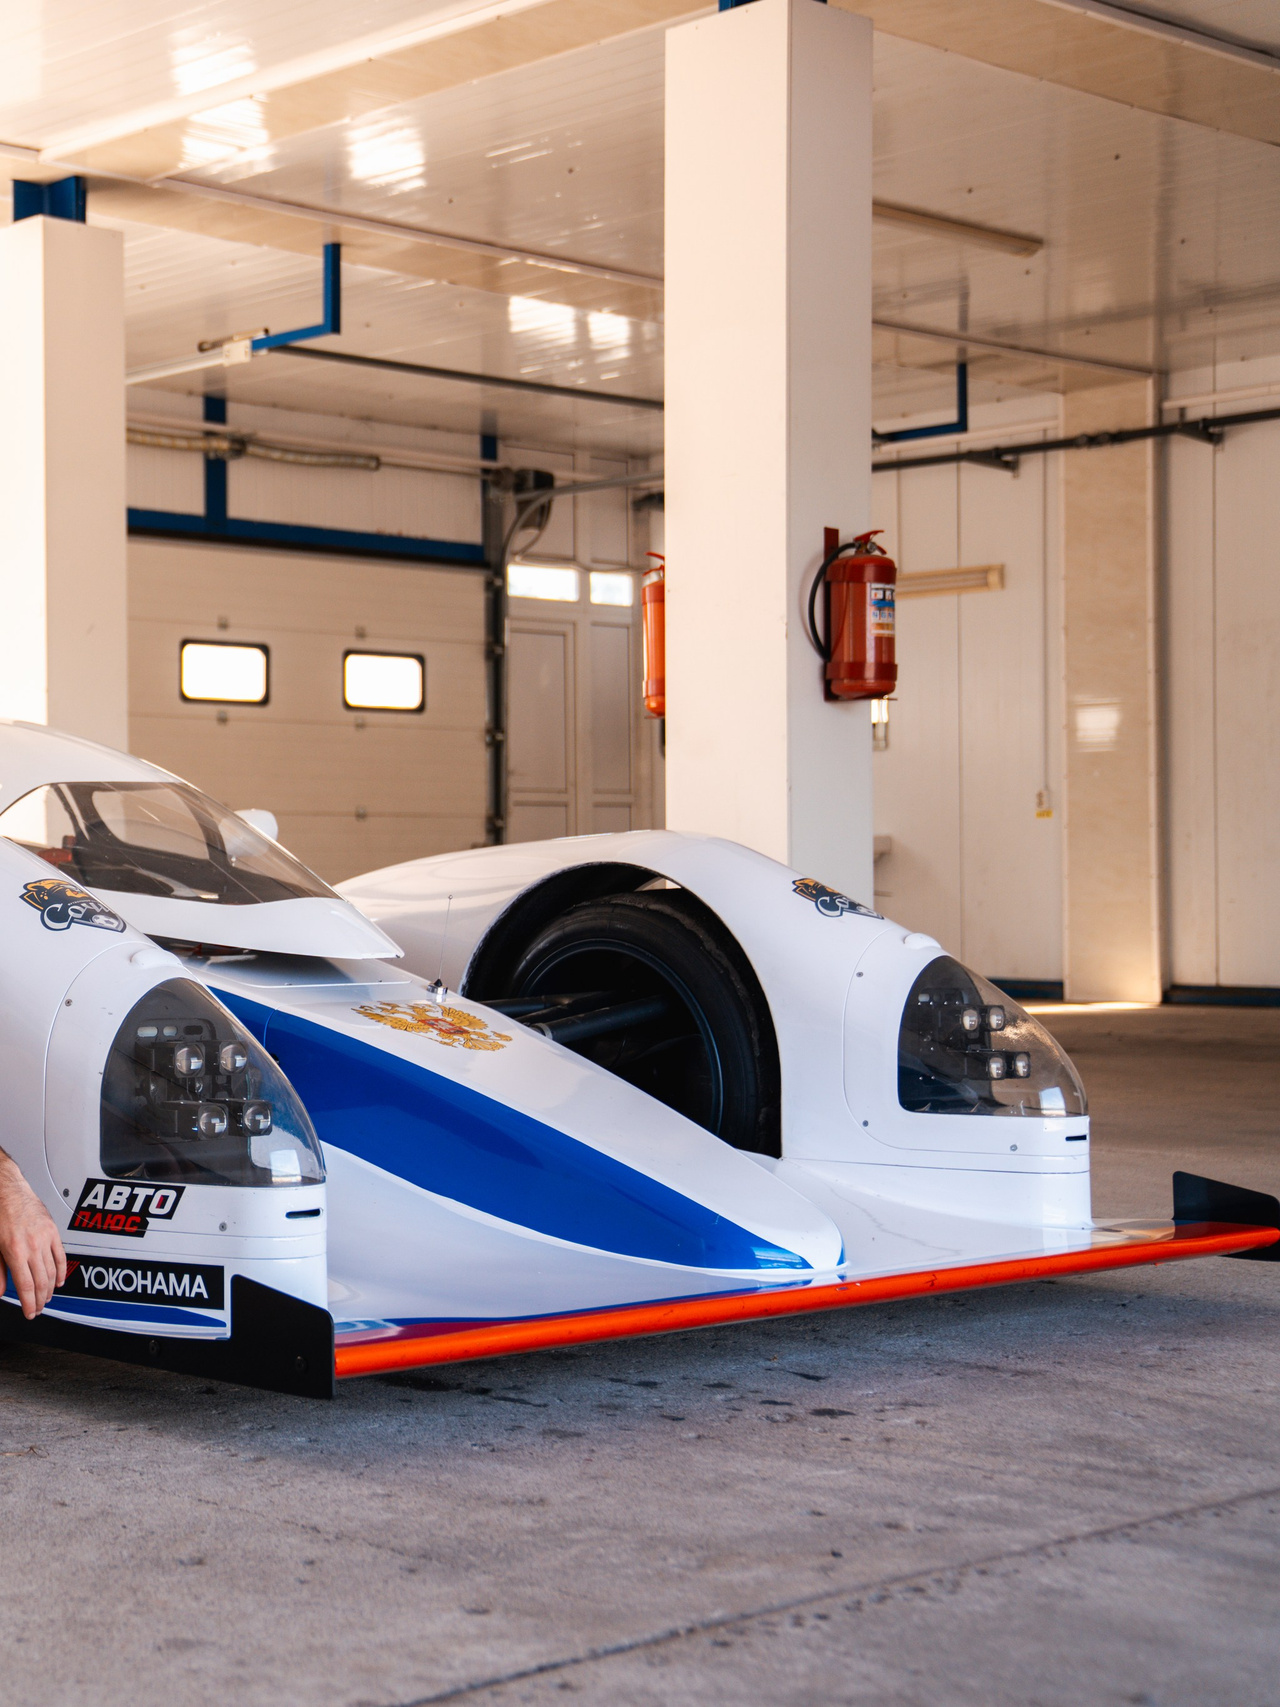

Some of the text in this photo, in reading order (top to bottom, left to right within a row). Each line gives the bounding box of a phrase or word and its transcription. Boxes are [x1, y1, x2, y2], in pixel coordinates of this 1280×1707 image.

[80, 1183, 177, 1216] АВТО
[73, 1210, 141, 1233] ПЛЮС
[79, 1264, 209, 1299] YOKOHAMA
